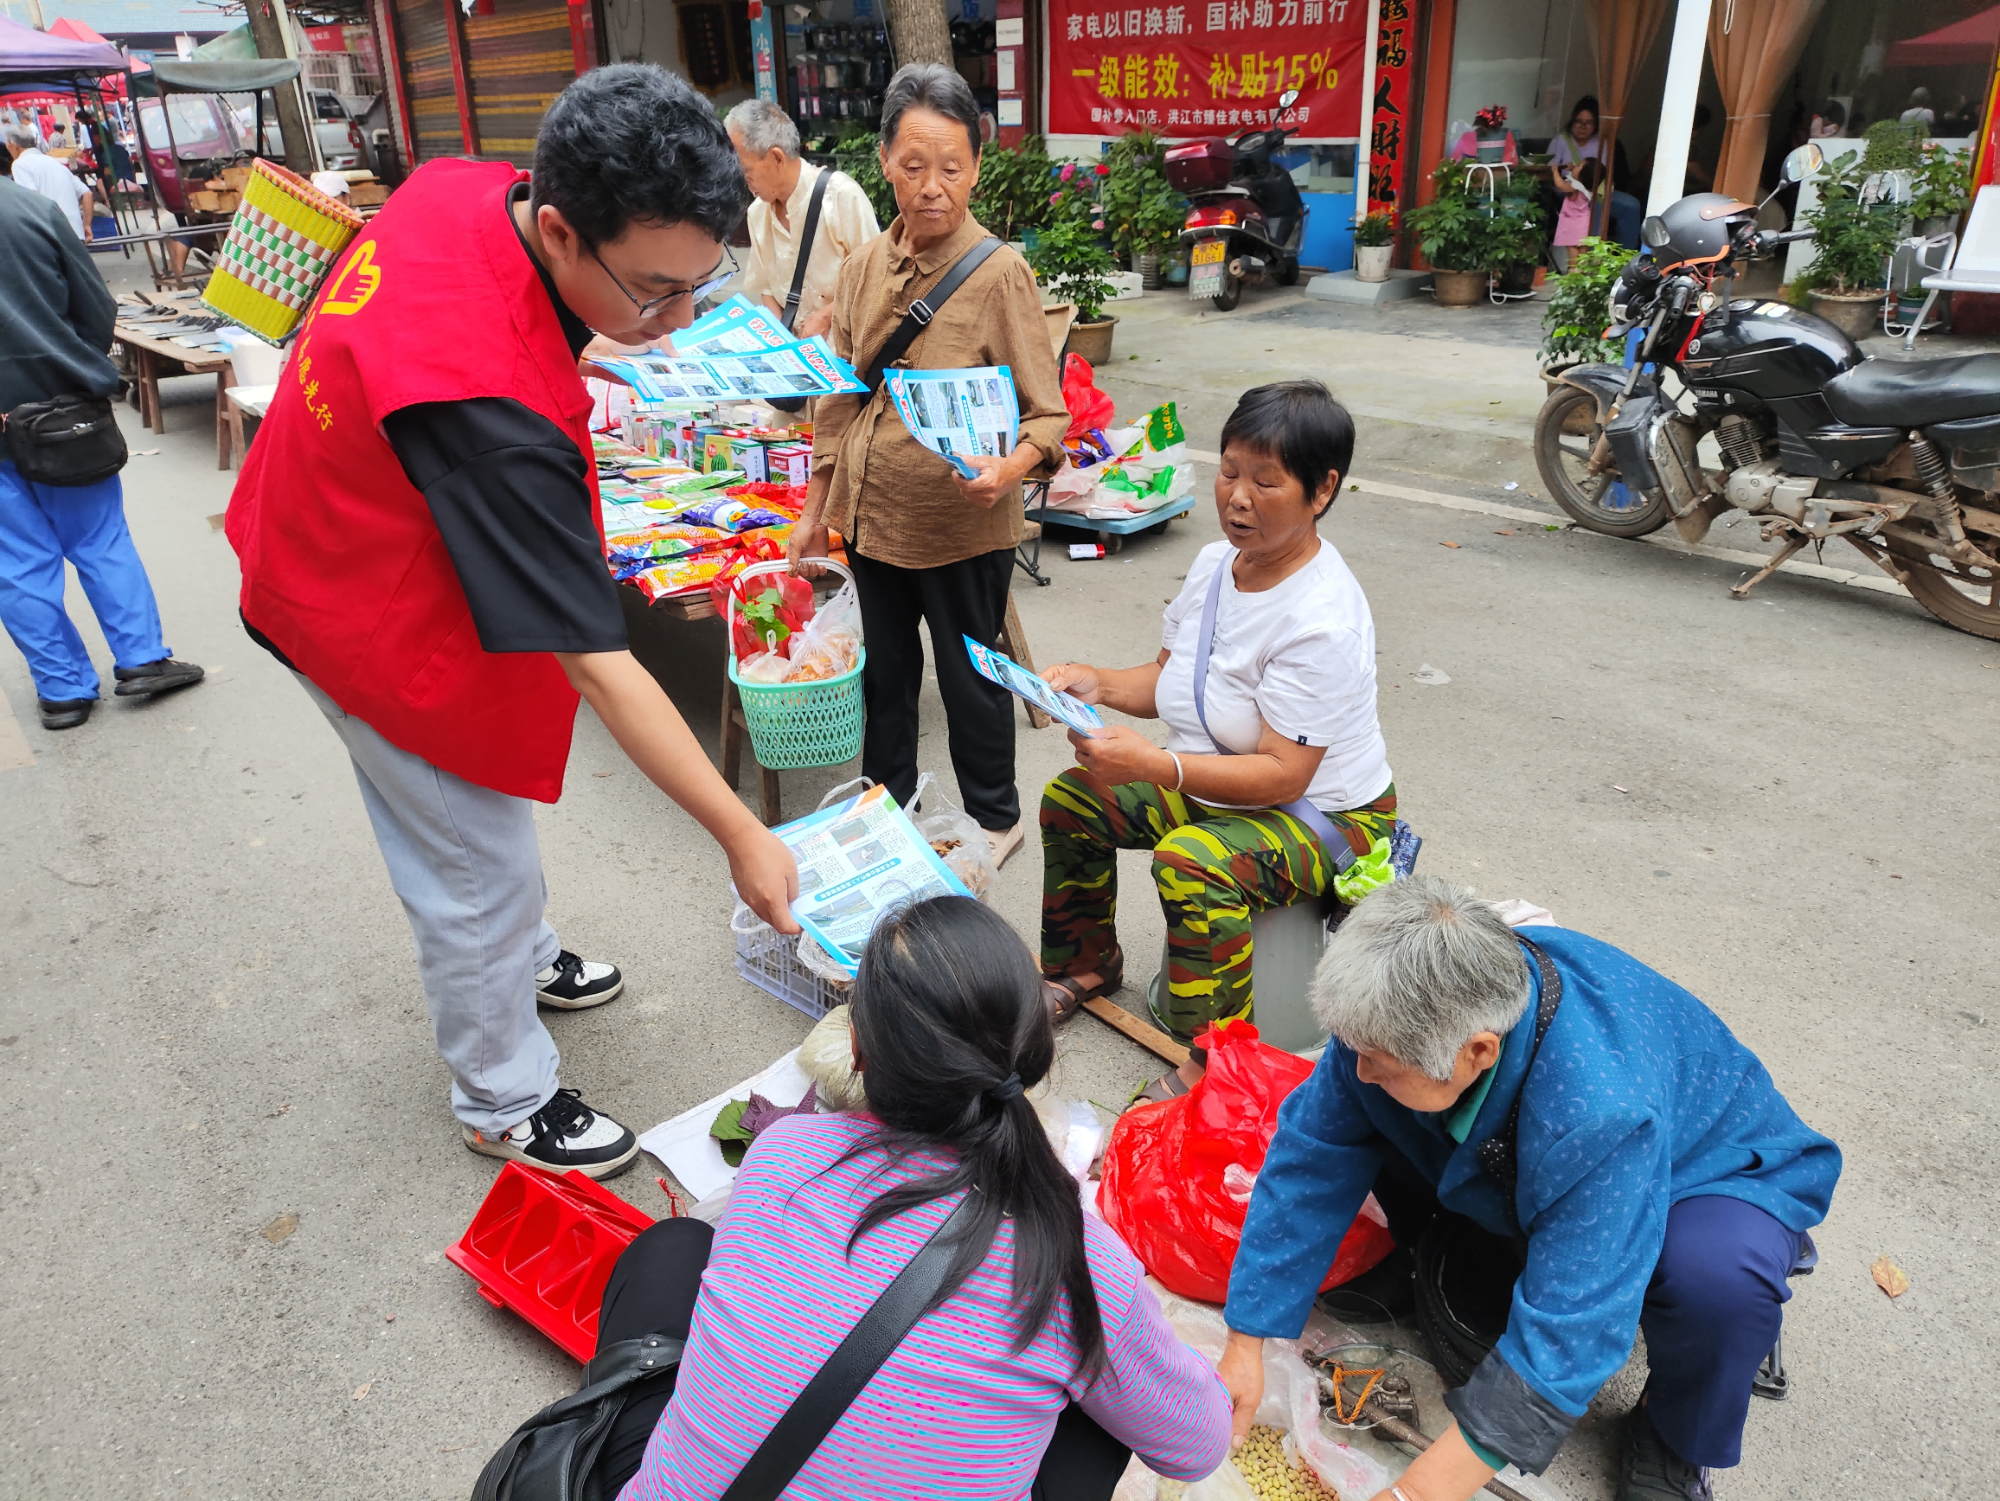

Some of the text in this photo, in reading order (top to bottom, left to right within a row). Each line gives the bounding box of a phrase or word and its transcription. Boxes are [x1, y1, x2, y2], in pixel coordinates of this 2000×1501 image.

[1067, 0, 1348, 41] 家电以旧换新，国补助力前行
[1695, 390, 1718, 398] YAMAHA
